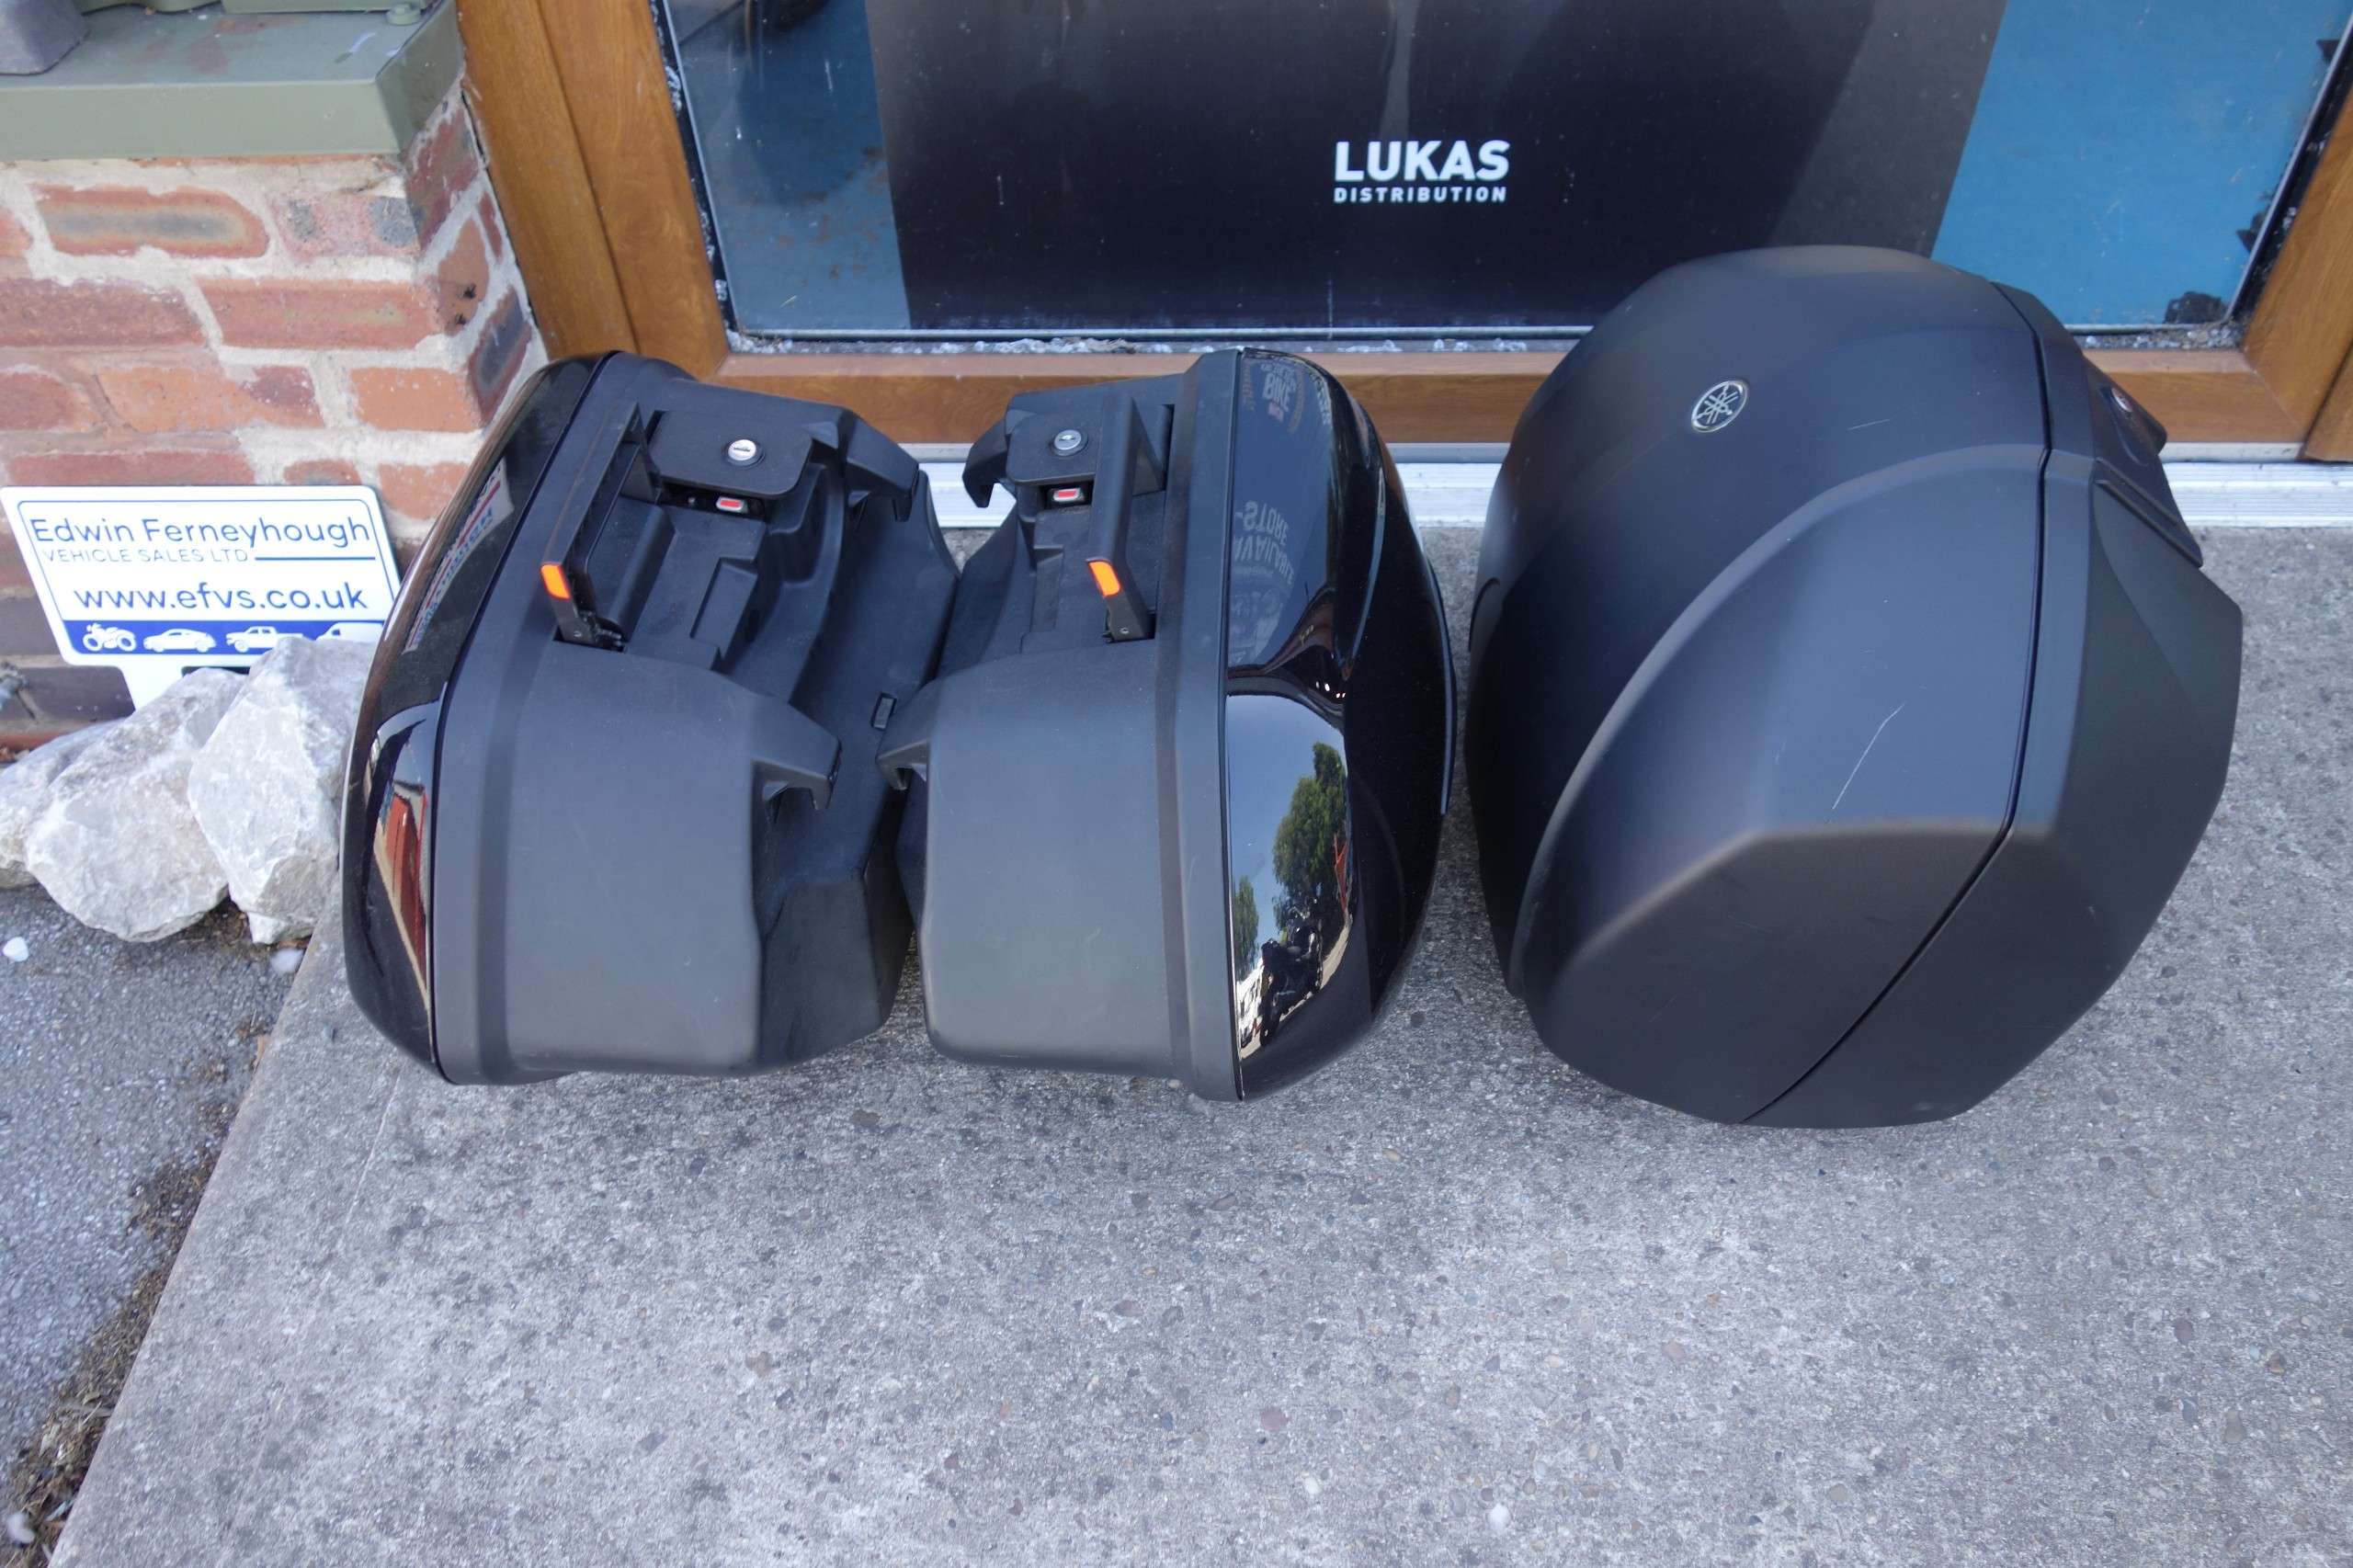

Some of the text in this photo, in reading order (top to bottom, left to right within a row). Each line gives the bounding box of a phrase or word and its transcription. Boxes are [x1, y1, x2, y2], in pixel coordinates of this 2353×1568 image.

[1335, 140, 1511, 181] LUKAS
[1334, 187, 1507, 202] DISTRIBUTION
[29, 517, 370, 548] Edwin Ferneyhough
[44, 548, 249, 562] VEHICLE SALES LTD
[74, 582, 368, 610] www.efvs.co.uk
